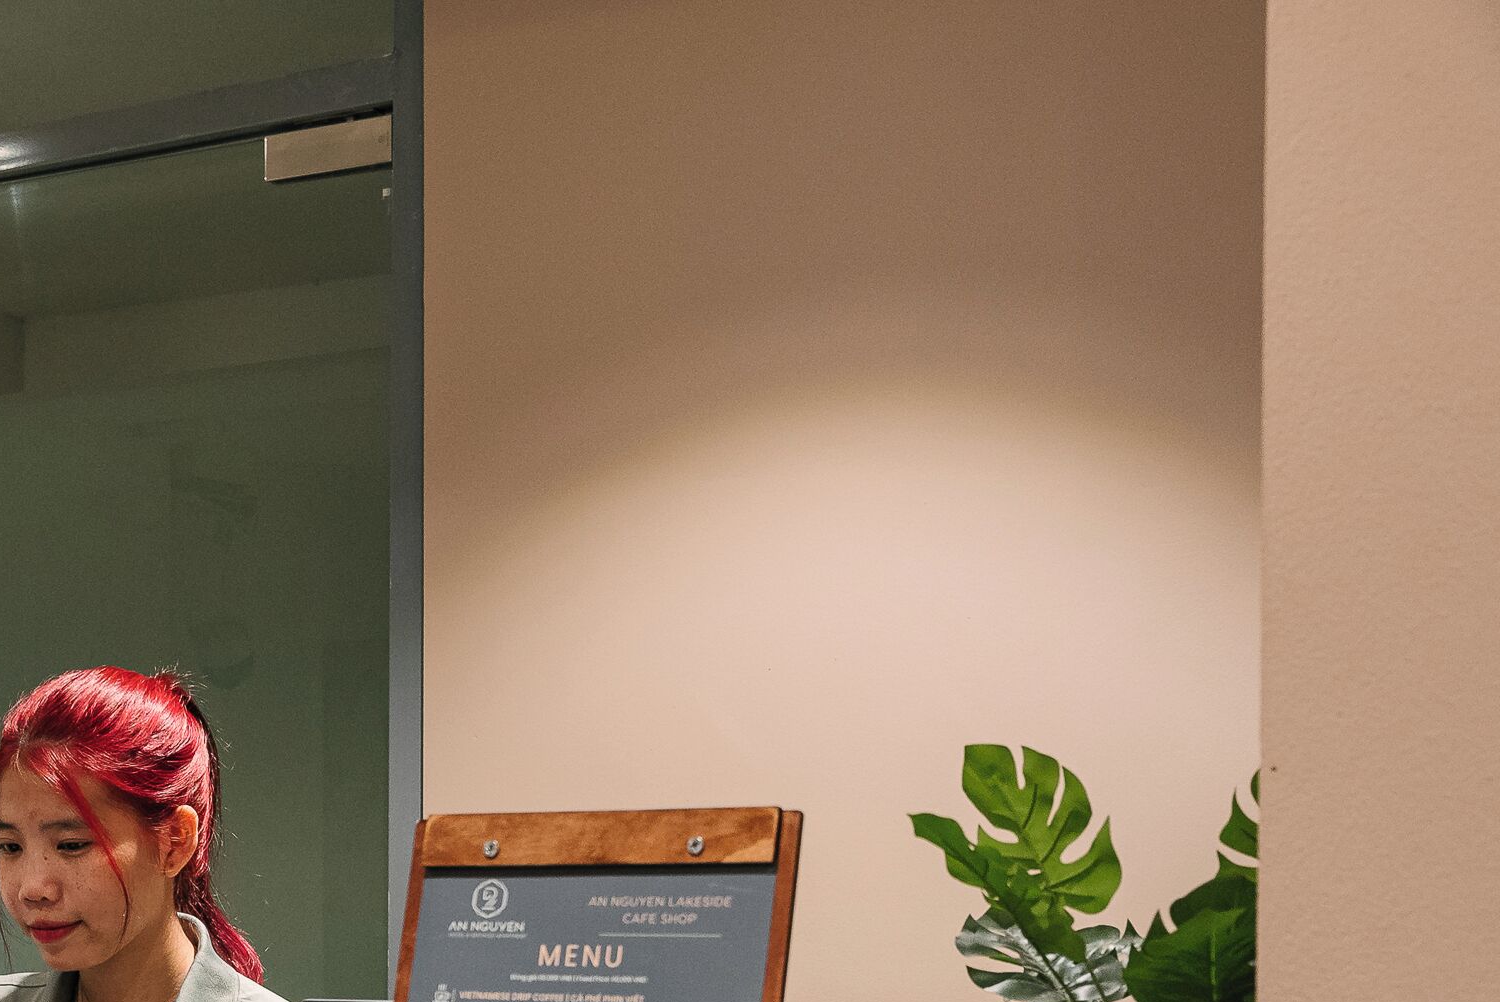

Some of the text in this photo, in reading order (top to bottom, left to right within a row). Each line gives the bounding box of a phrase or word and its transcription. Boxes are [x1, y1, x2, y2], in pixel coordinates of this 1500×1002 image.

[587, 895, 733, 909] AN NGUYEN LAKESIDE
[621, 912, 698, 925] CAFE SHOP
[448, 920, 526, 933] AN NGUYEN
[537, 943, 625, 969] MENU
